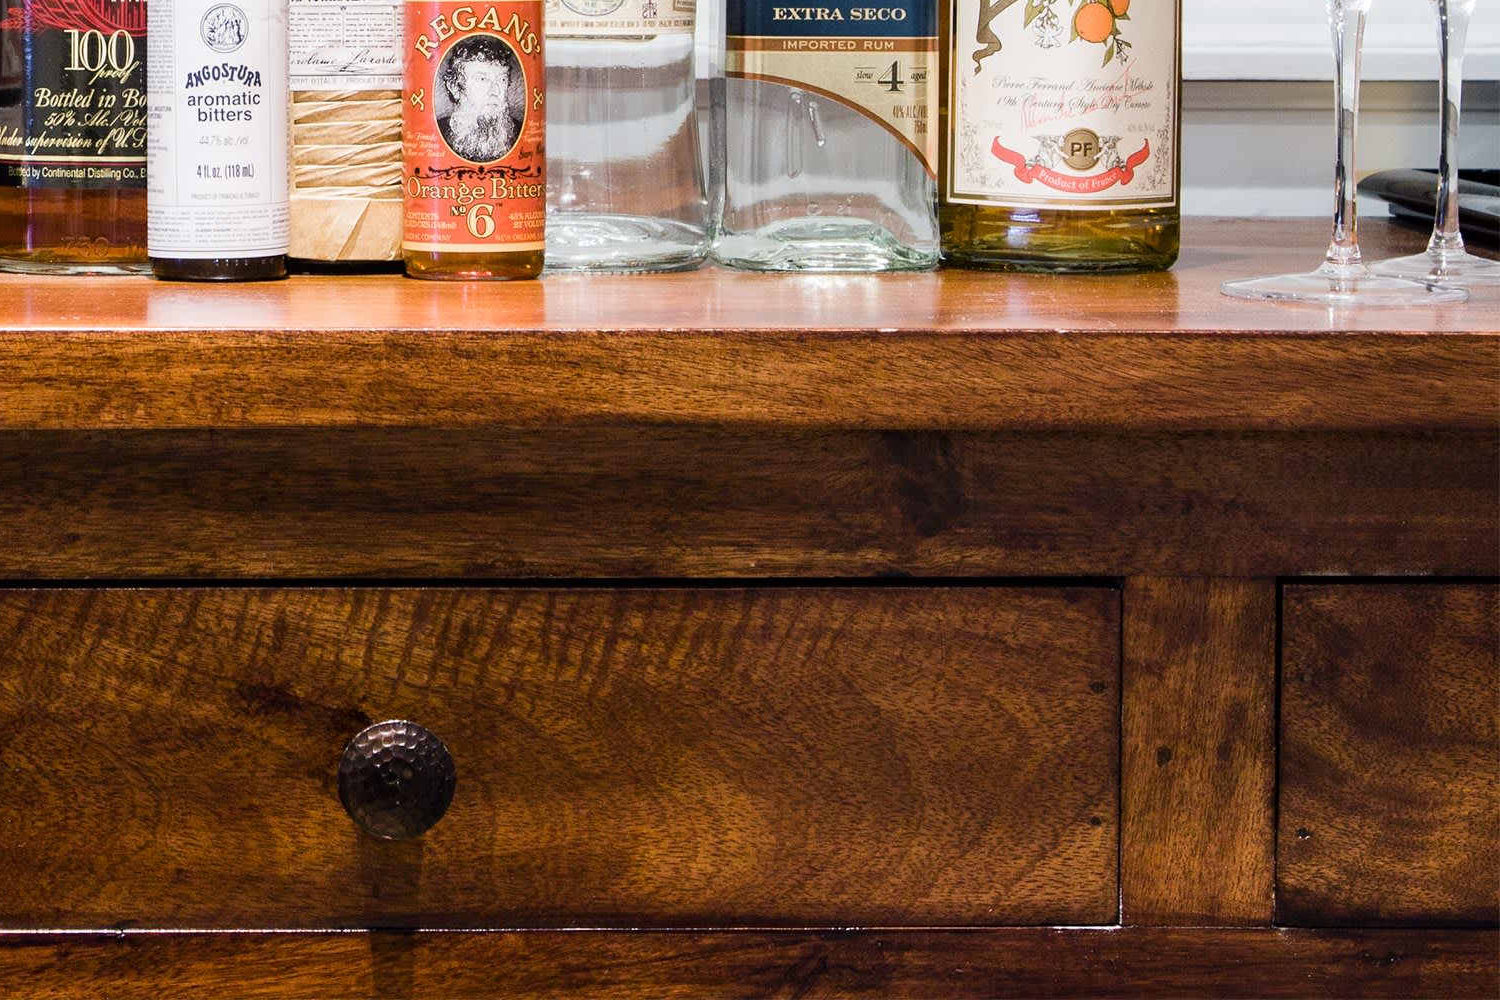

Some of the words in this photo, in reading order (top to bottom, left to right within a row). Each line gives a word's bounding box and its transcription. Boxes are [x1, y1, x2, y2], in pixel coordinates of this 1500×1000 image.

[773, 7, 844, 21] EXTRA
[850, 7, 906, 21] SECO
[64, 29, 135, 72] 100
[783, 40, 857, 50] IMPORTED
[863, 40, 894, 50] RUM
[88, 60, 140, 85] proof
[185, 63, 262, 89] ANGOSTURA
[855, 70, 874, 80] slow
[877, 60, 904, 92] 4
[910, 70, 927, 81] aged
[991, 75, 1026, 89] Pierre
[1027, 76, 1076, 91] Ferrand
[34, 87, 95, 108] Bottled
[98, 89, 116, 107] in
[122, 87, 147, 107] Bo
[187, 92, 261, 107] aromatic
[44, 110, 76, 126] 50%
[197, 107, 253, 122] bitters
[25, 130, 92, 154] supervision
[95, 126, 114, 154] of
[1071, 142, 1092, 157] PF
[8, 166, 31, 177] Bottled
[31, 167, 41, 179] by
[41, 166, 86, 178] Continental
[87, 166, 122, 180] Distilling
[196, 165, 202, 178] 4
[212, 167, 222, 178] oz.
[224, 164, 241, 179] (118
[242, 163, 255, 179] mL)
[1039, 170, 1077, 189] Product
[1078, 177, 1089, 189] of
[1090, 172, 1118, 189] France
[407, 176, 485, 205] Orange
[467, 203, 496, 240] 6
